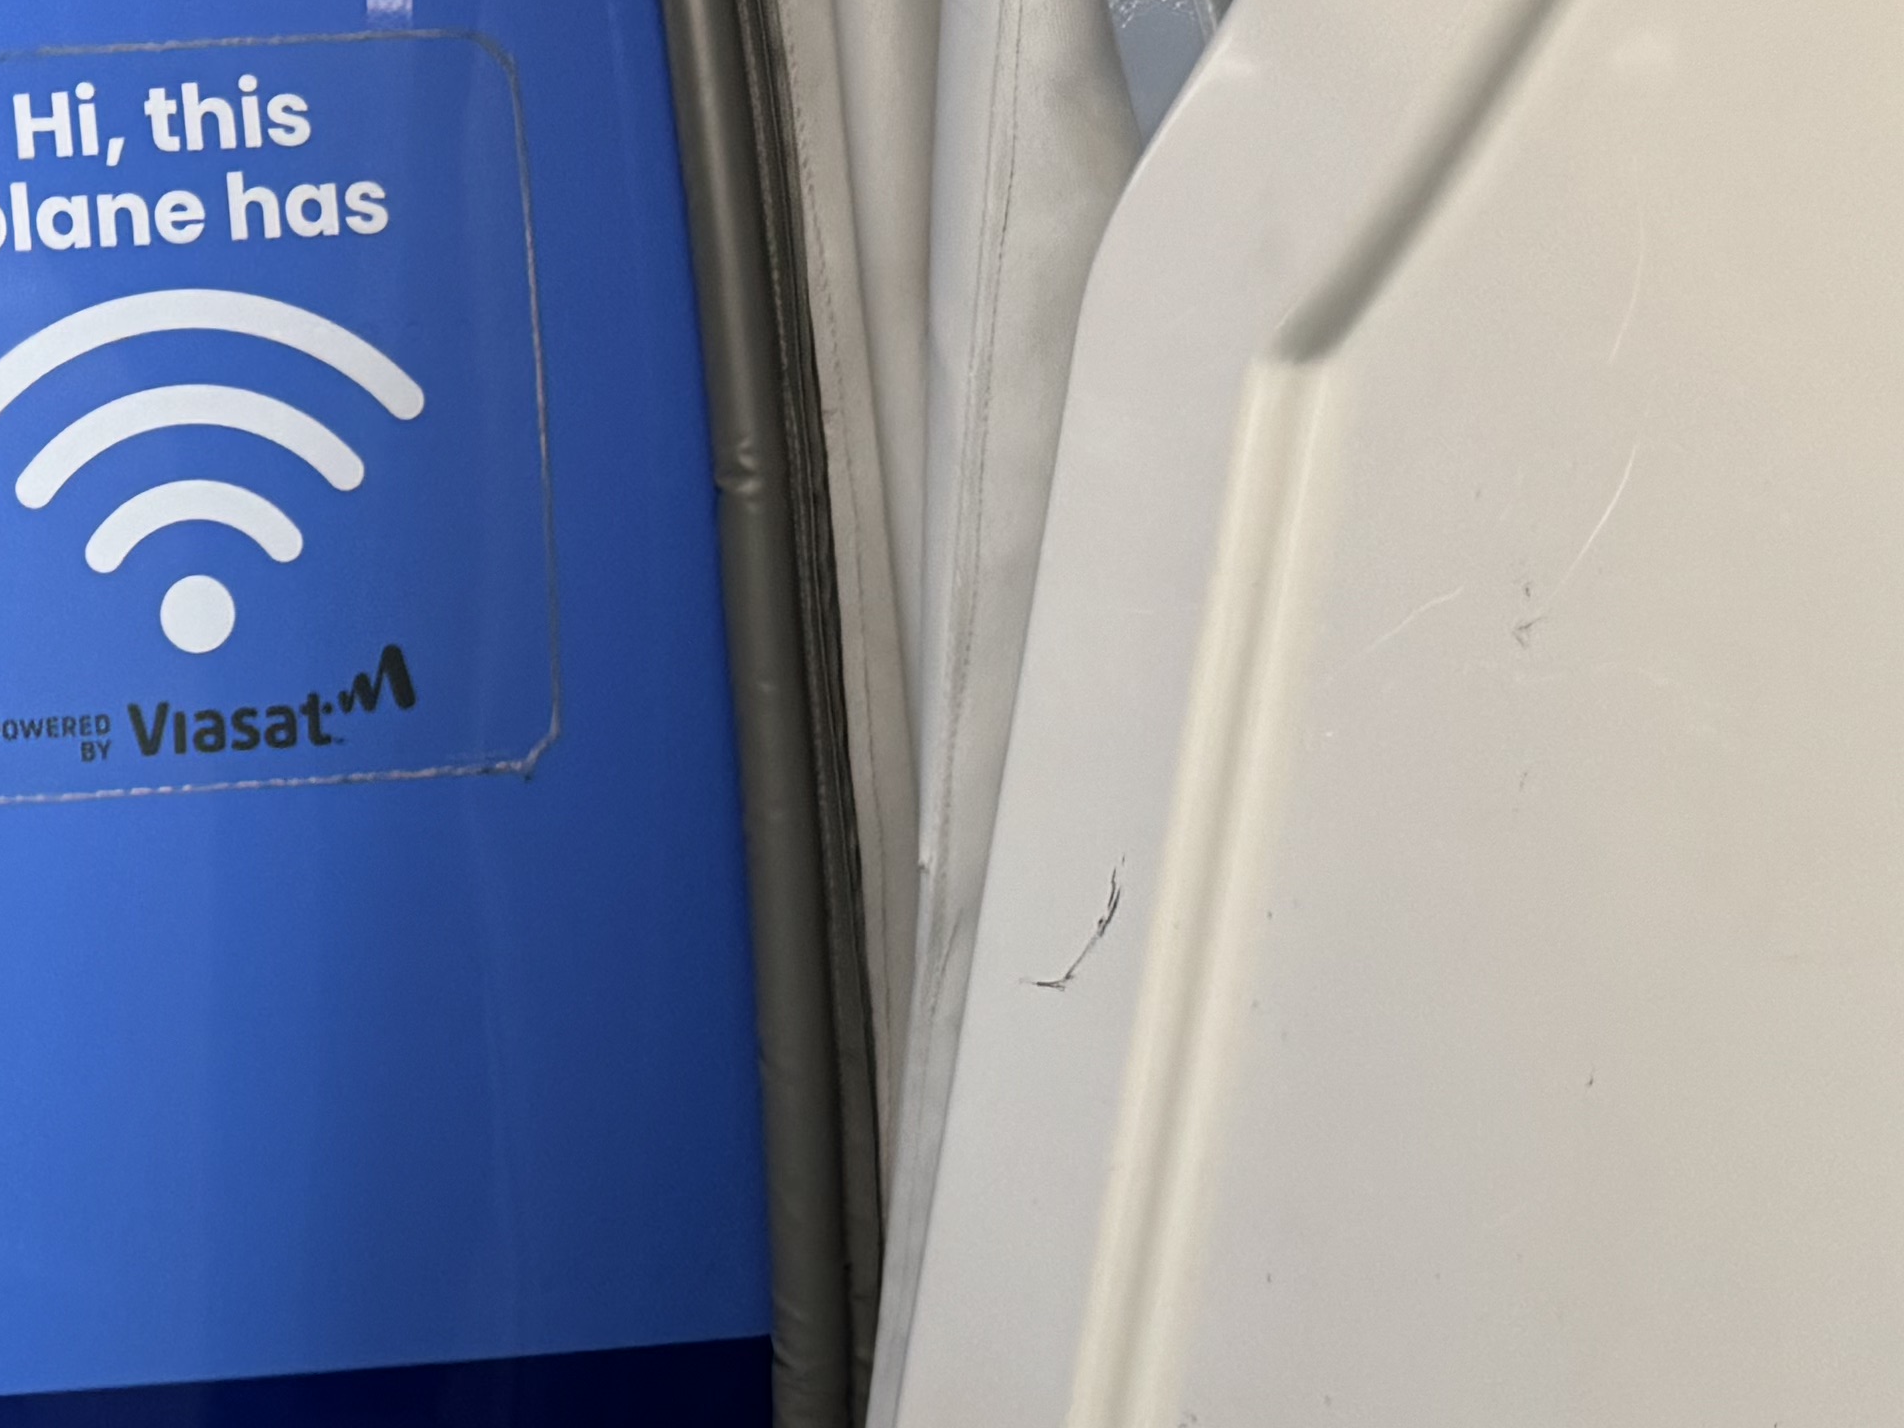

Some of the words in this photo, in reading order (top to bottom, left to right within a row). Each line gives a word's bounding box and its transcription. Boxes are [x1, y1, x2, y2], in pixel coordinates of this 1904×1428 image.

[11, 81, 125, 167] Hi,
[143, 74, 311, 152] this
[226, 171, 389, 241] has
[80, 740, 112, 763] BY
[126, 691, 334, 758] Viasat
